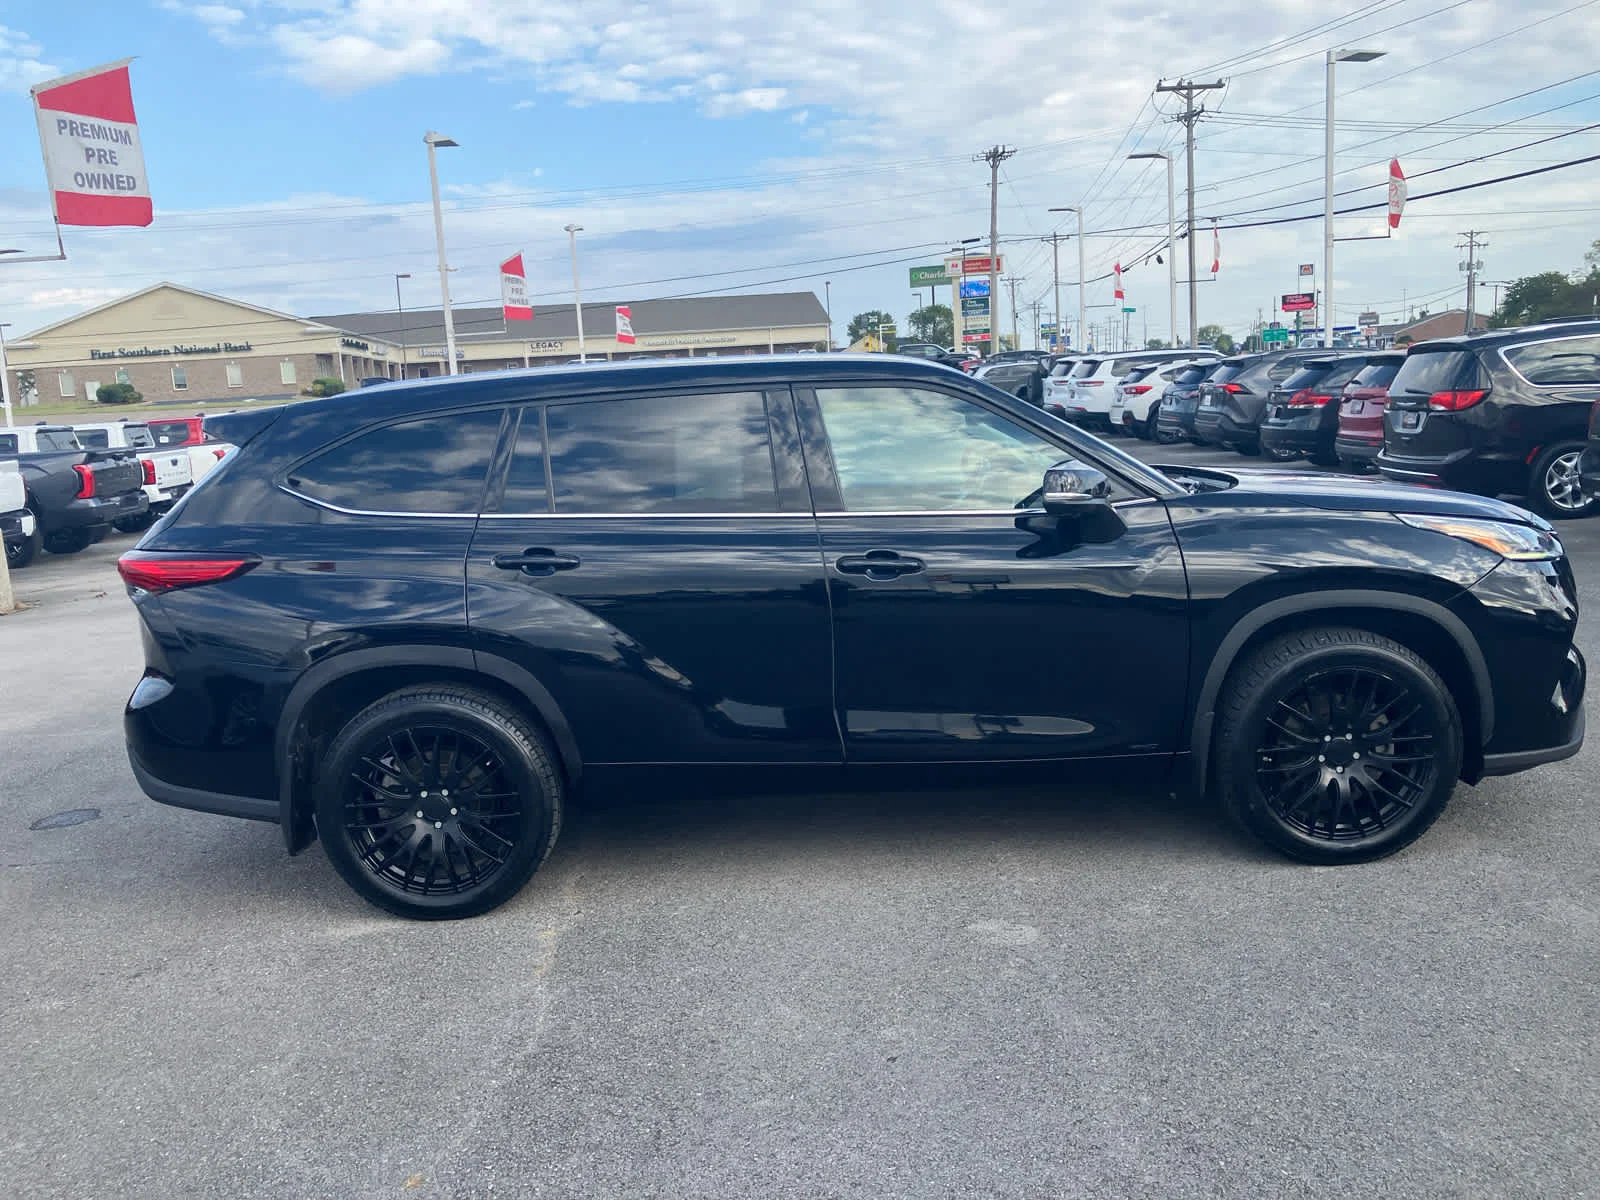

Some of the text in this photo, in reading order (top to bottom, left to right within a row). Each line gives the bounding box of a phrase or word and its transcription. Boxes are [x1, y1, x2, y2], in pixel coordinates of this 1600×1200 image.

[56, 118, 133, 145] PREMIUM
[85, 147, 119, 166] PRE
[74, 172, 137, 191] OWNED
[89, 340, 252, 360] First Southern National Bank
[530, 341, 563, 349] LEGACY
